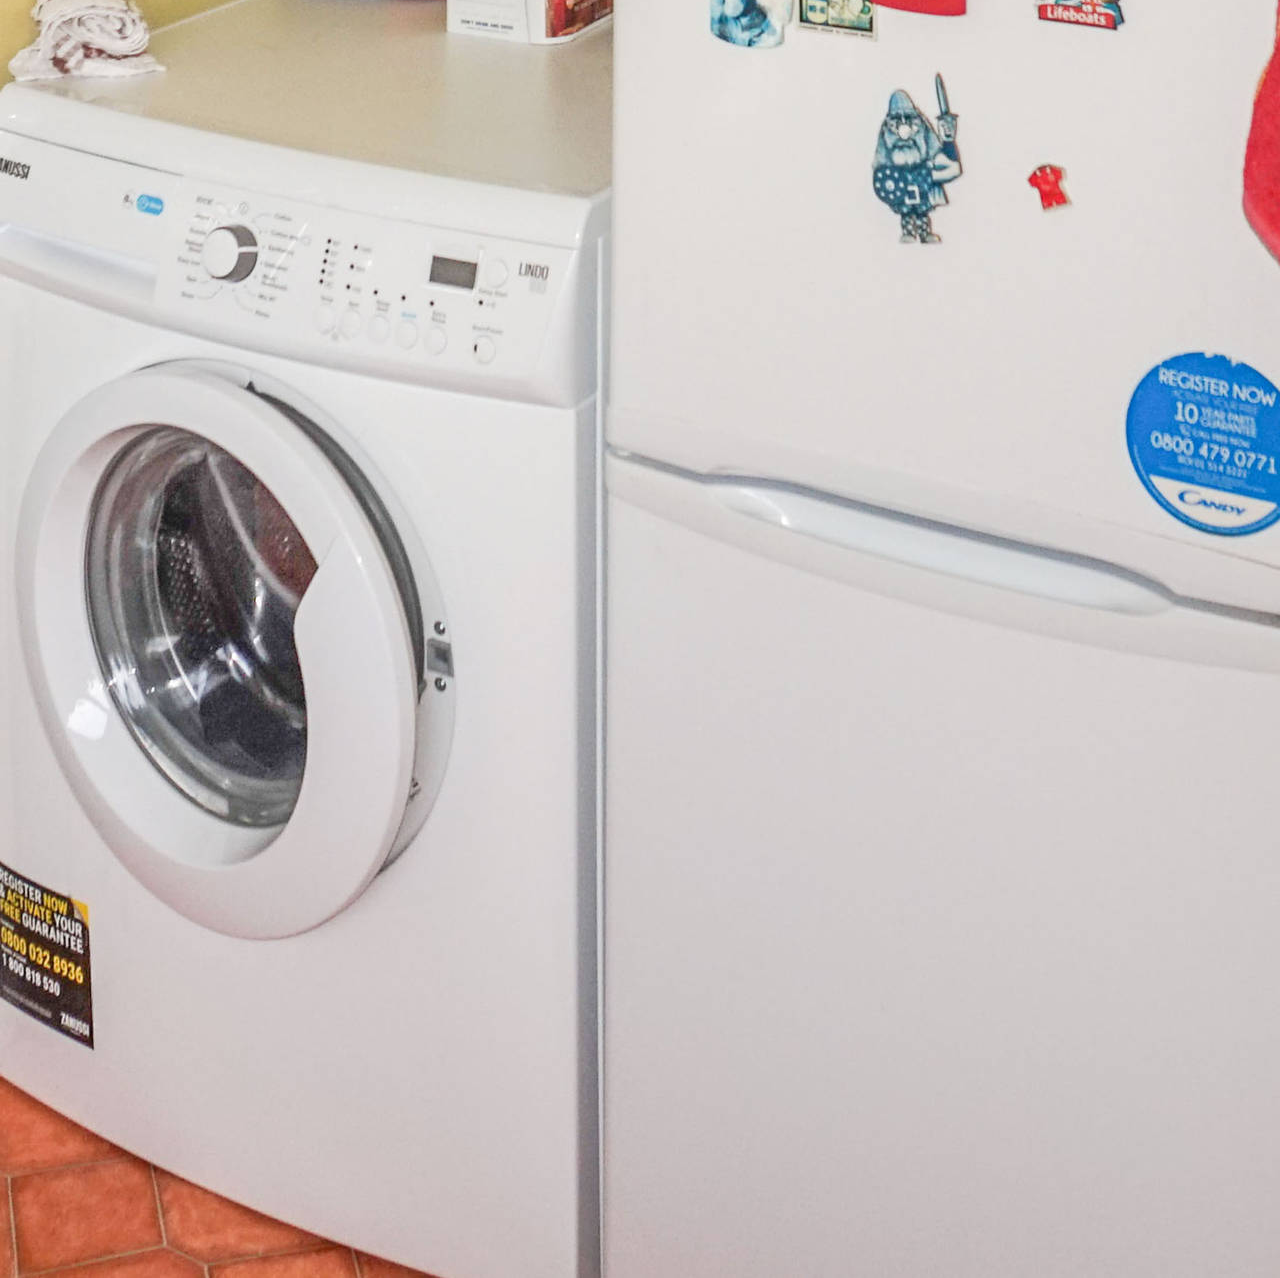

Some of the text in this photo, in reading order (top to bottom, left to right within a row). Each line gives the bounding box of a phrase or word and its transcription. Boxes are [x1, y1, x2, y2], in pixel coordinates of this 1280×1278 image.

[1046, 4, 1107, 25] Lifeboats
[518, 262, 549, 281] LINDO
[1158, 367, 1229, 398] REGISTER
[1232, 382, 1277, 407] NOW
[1174, 401, 1198, 424] 10
[1150, 430, 1194, 456] 0800
[1199, 442, 1230, 463] 479
[1234, 449, 1277, 475] 0771
[1178, 490, 1246, 515] CANDY
[7, 889, 52, 924] ACTIVATE
[54, 915, 83, 938] YOUR
[43, 892, 68, 915] NOW
[0, 897, 20, 922] FREE
[21, 914, 84, 954] GUARANTEE
[0, 926, 27, 956] 0800
[28, 943, 51, 969] 032
[53, 955, 84, 984] 8936
[8, 960, 24, 977] 800
[60, 1012, 90, 1038] ZANUSSI
